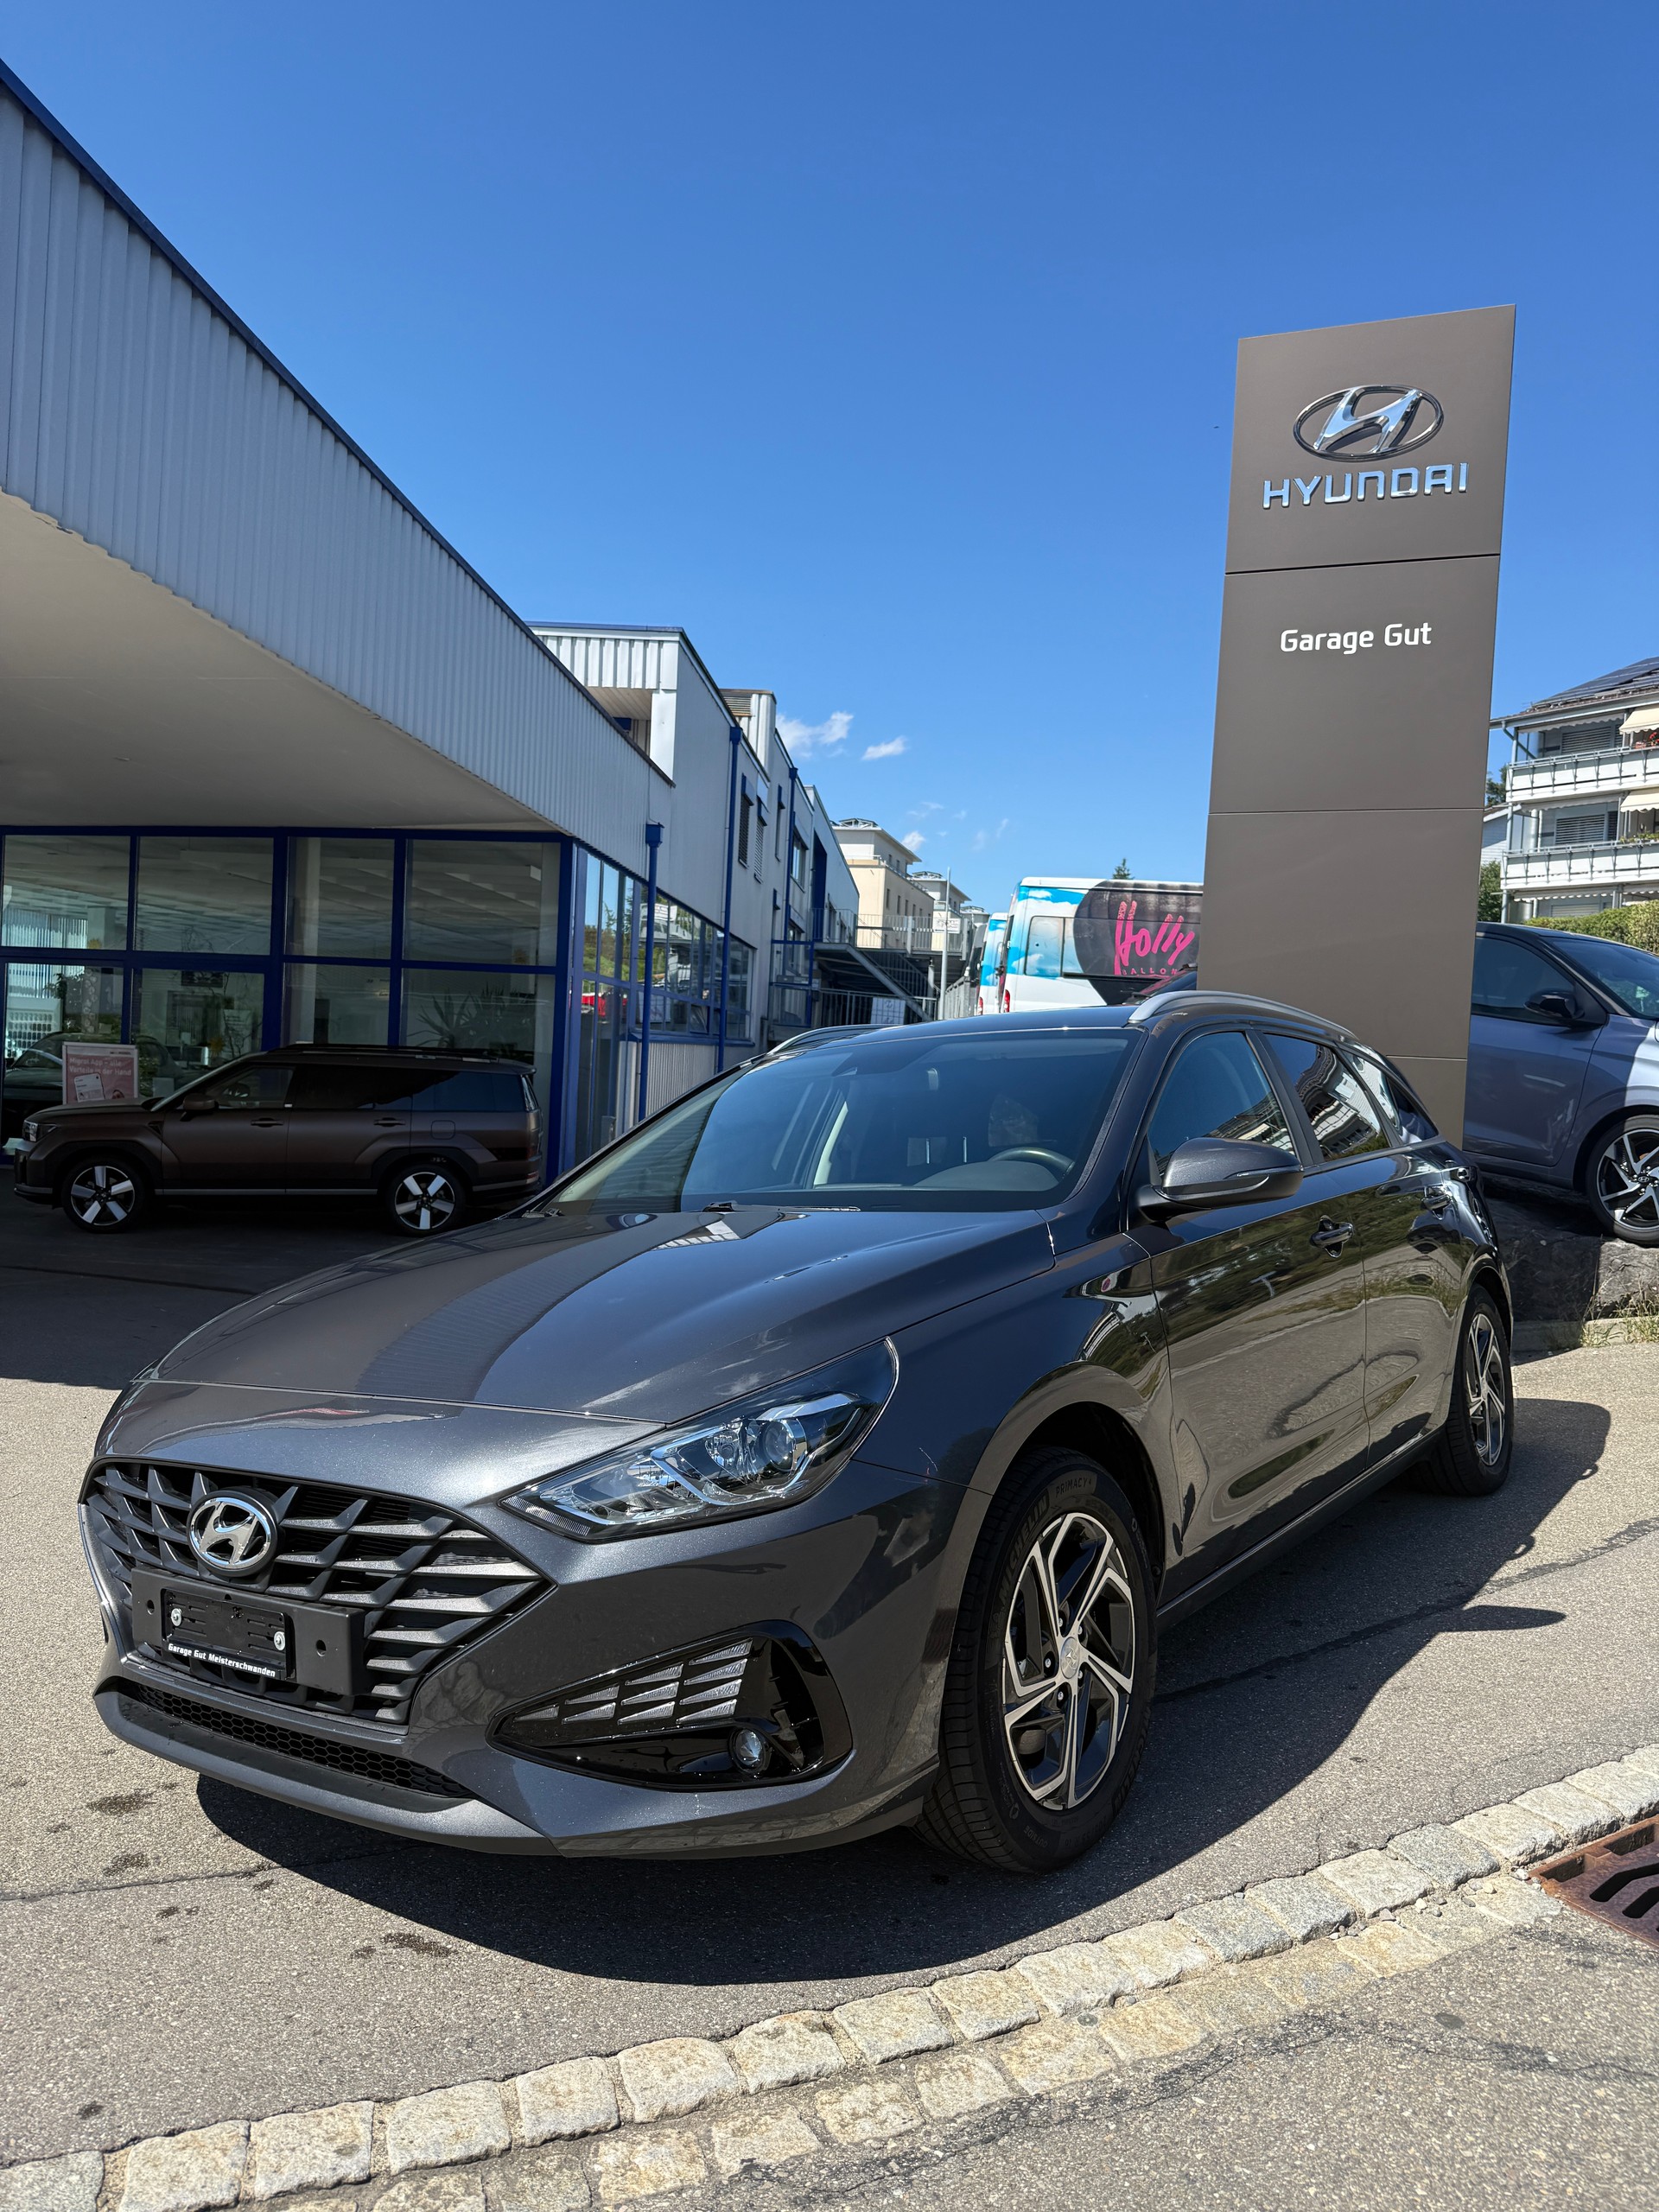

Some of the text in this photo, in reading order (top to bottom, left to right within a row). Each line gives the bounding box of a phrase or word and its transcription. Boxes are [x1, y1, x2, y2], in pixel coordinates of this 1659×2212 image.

[1262, 462, 1470, 510] HYUNDAI
[1281, 622, 1433, 654] Garage Gut
[1115, 900, 1195, 976] Holly
[1055, 1478, 1088, 1497] PRIMACY
[999, 1494, 1049, 1605] MICHELIN
[168, 1643, 276, 1677] Garage Gut Meisterschwanden
[1023, 1824, 1049, 1848] OUTSIDE
